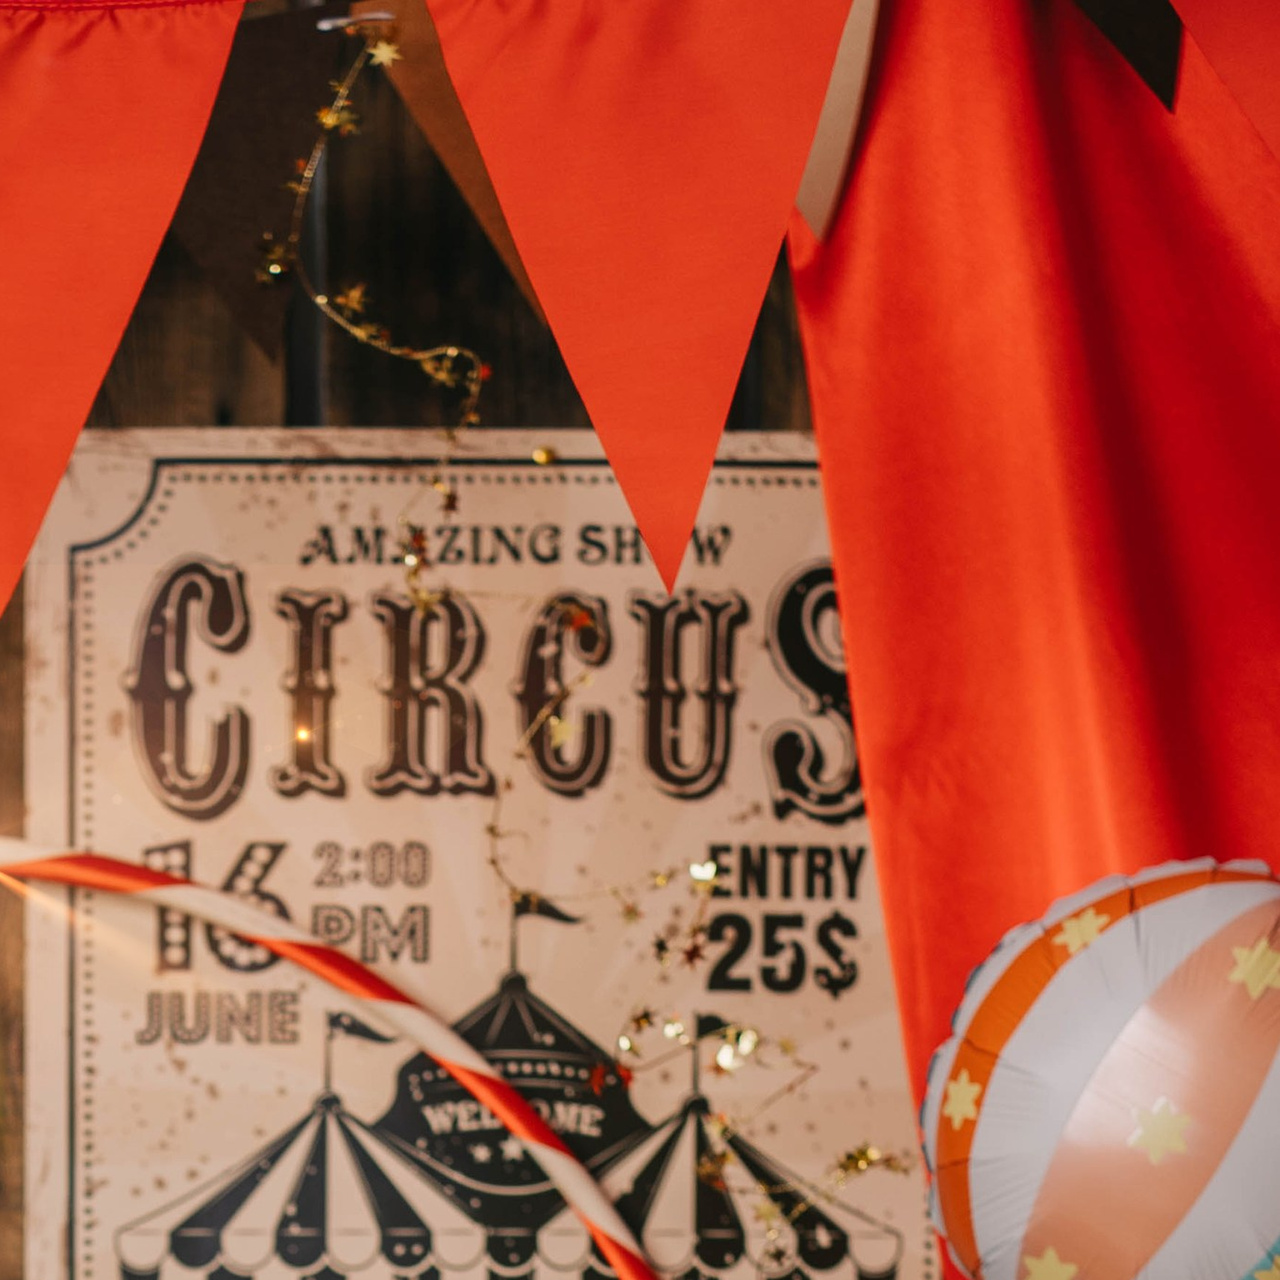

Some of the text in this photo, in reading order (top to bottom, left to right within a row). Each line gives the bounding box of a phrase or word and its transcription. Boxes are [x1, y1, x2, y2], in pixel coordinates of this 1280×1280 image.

[299, 523, 732, 567] AMAZING SHW
[126, 553, 867, 827] CIRCUS
[314, 840, 432, 888] 2:00
[709, 844, 866, 899] ENTRY
[143, 839, 292, 972] 16
[311, 904, 431, 963] PM
[706, 908, 859, 1000] 25$
[135, 990, 299, 1045] JUNE
[422, 1098, 606, 1138] WELOME
